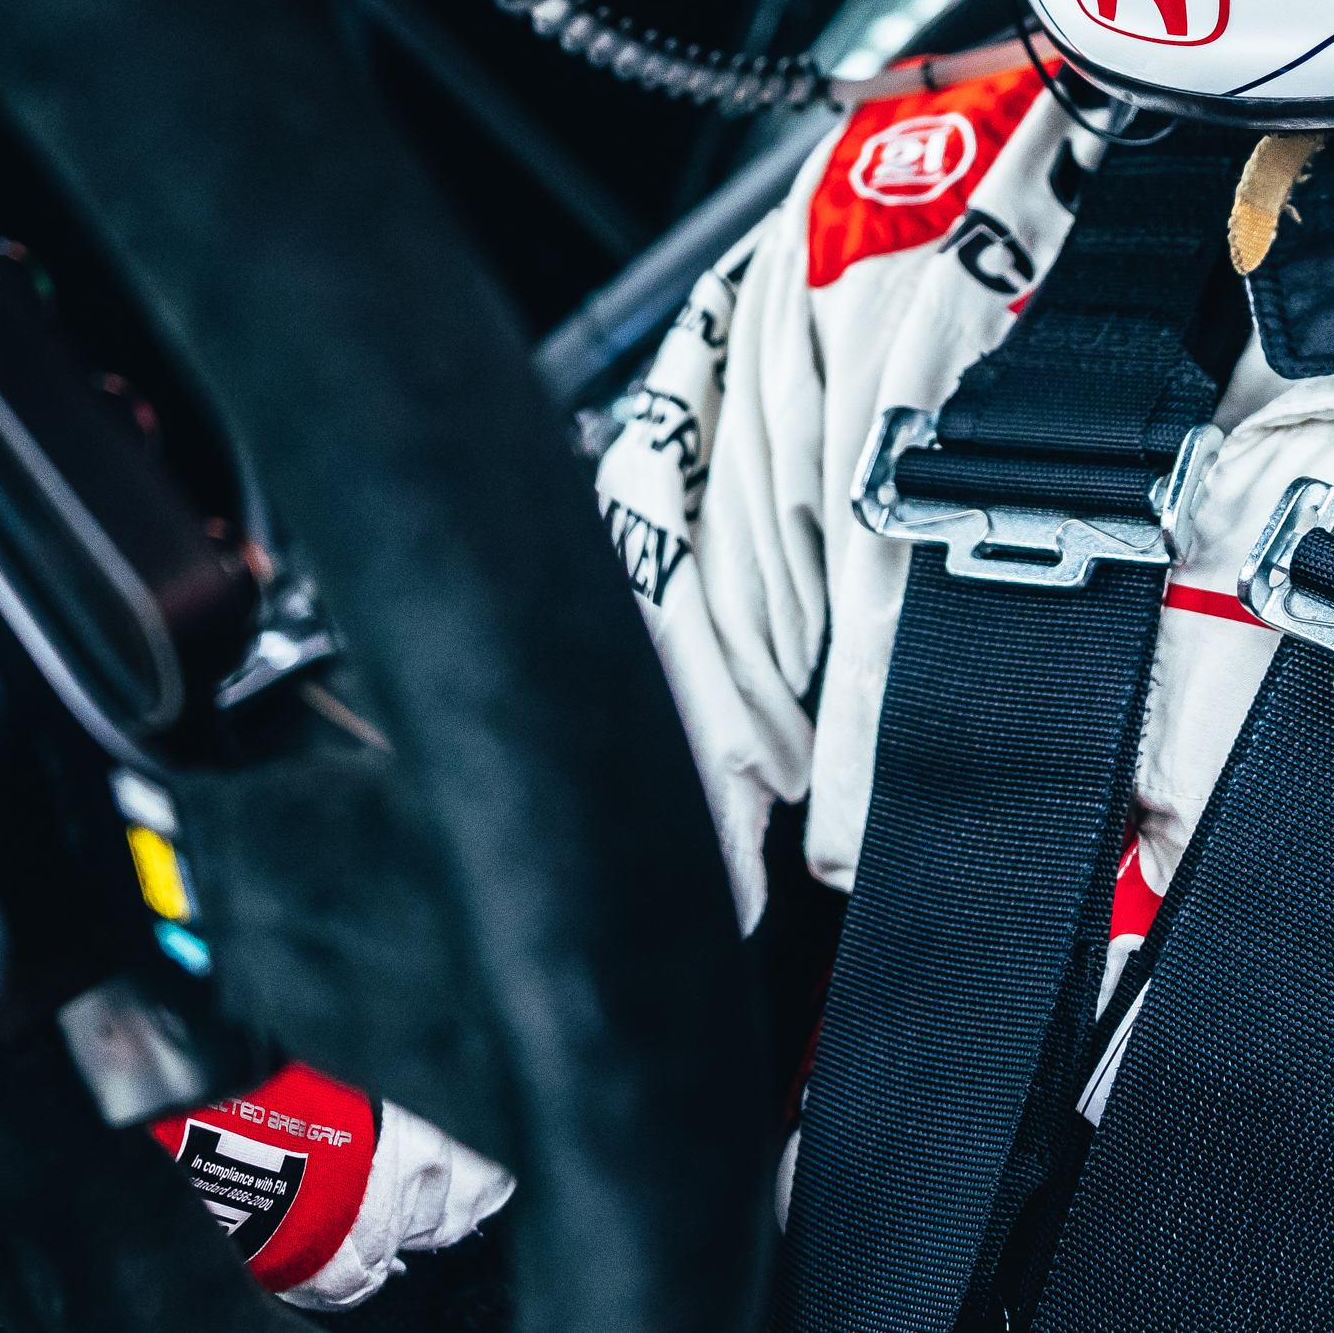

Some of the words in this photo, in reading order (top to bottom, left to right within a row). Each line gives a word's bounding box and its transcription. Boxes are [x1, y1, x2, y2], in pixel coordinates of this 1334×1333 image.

[306, 1123, 352, 1147] GRIP
[190, 1154, 202, 1168] In
[203, 1159, 254, 1187] compliance
[255, 1175, 274, 1193] with
[272, 1179, 288, 1195] FIA
[228, 1186, 274, 1212] 8856-2000
